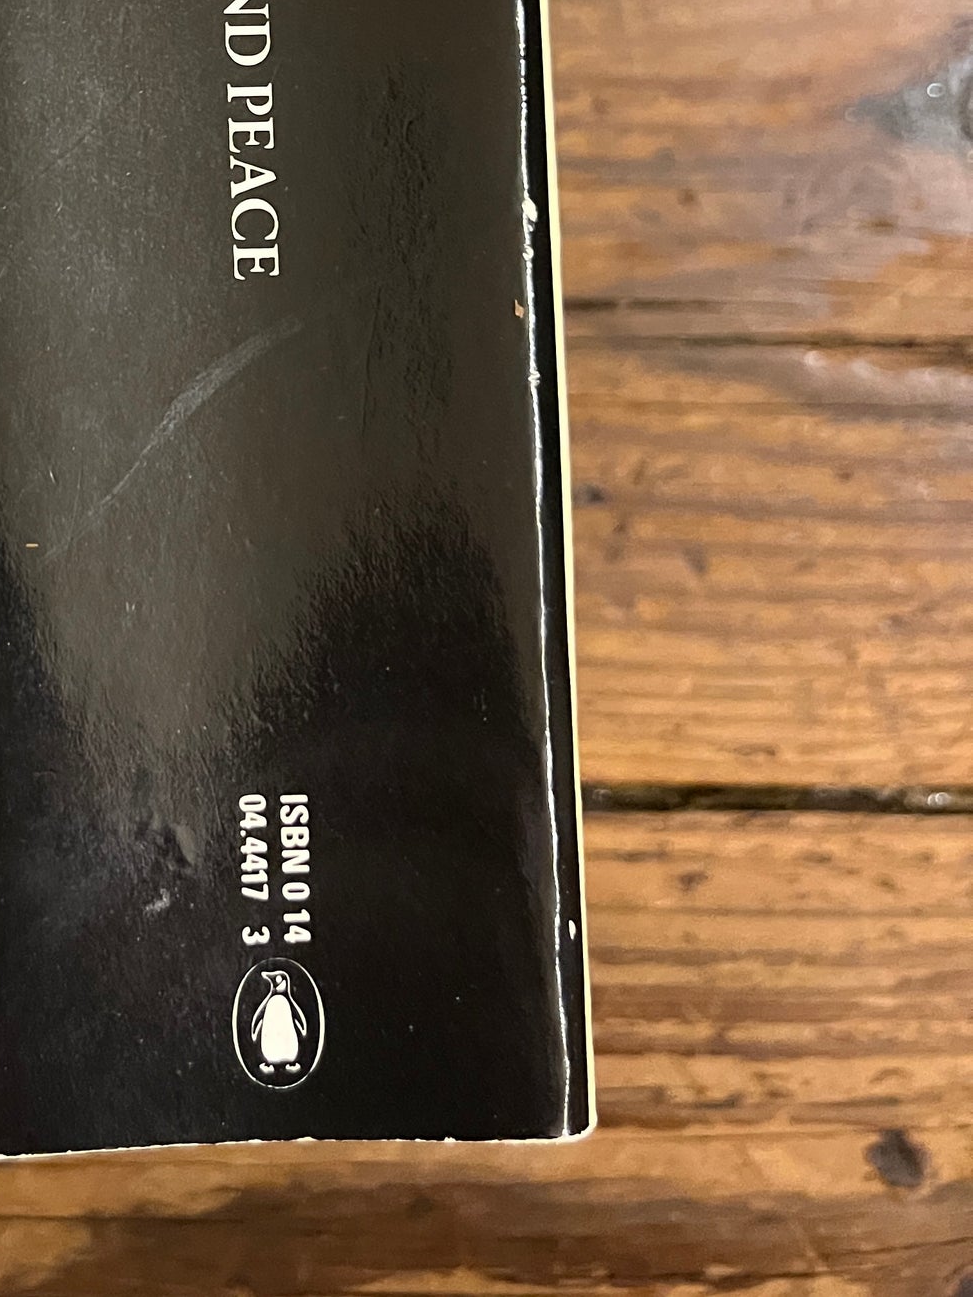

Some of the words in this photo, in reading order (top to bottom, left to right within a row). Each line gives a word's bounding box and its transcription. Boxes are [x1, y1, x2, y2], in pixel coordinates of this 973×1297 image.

[225, 81, 281, 282] PEACE
[279, 793, 311, 874] ISBN
[281, 881, 312, 902] 0
[241, 925, 272, 946] 3
[282, 908, 313, 944] 14
